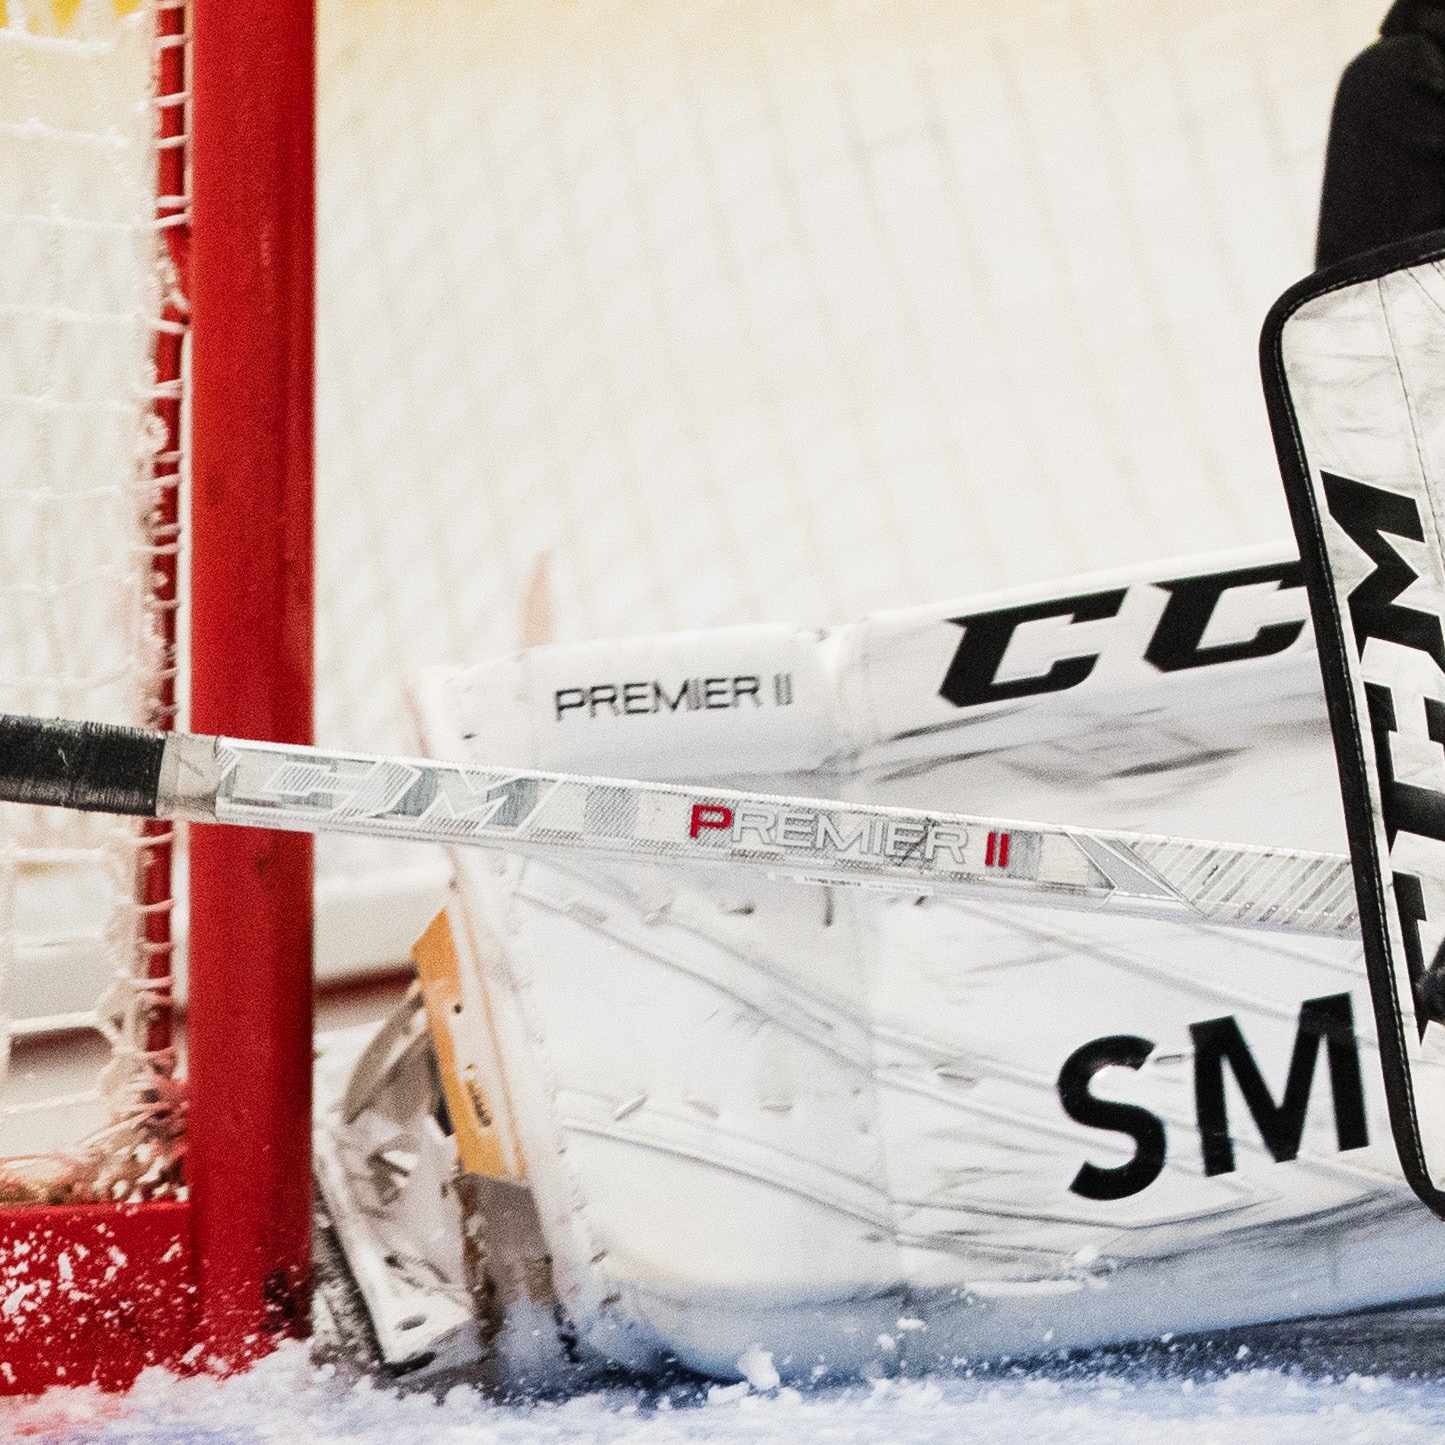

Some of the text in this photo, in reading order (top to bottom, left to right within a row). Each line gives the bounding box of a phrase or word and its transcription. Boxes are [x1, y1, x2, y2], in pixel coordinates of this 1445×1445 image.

[938, 559, 1307, 708] CC
[555, 672, 764, 723] PREMIER
[689, 803, 969, 865] PREMIER
